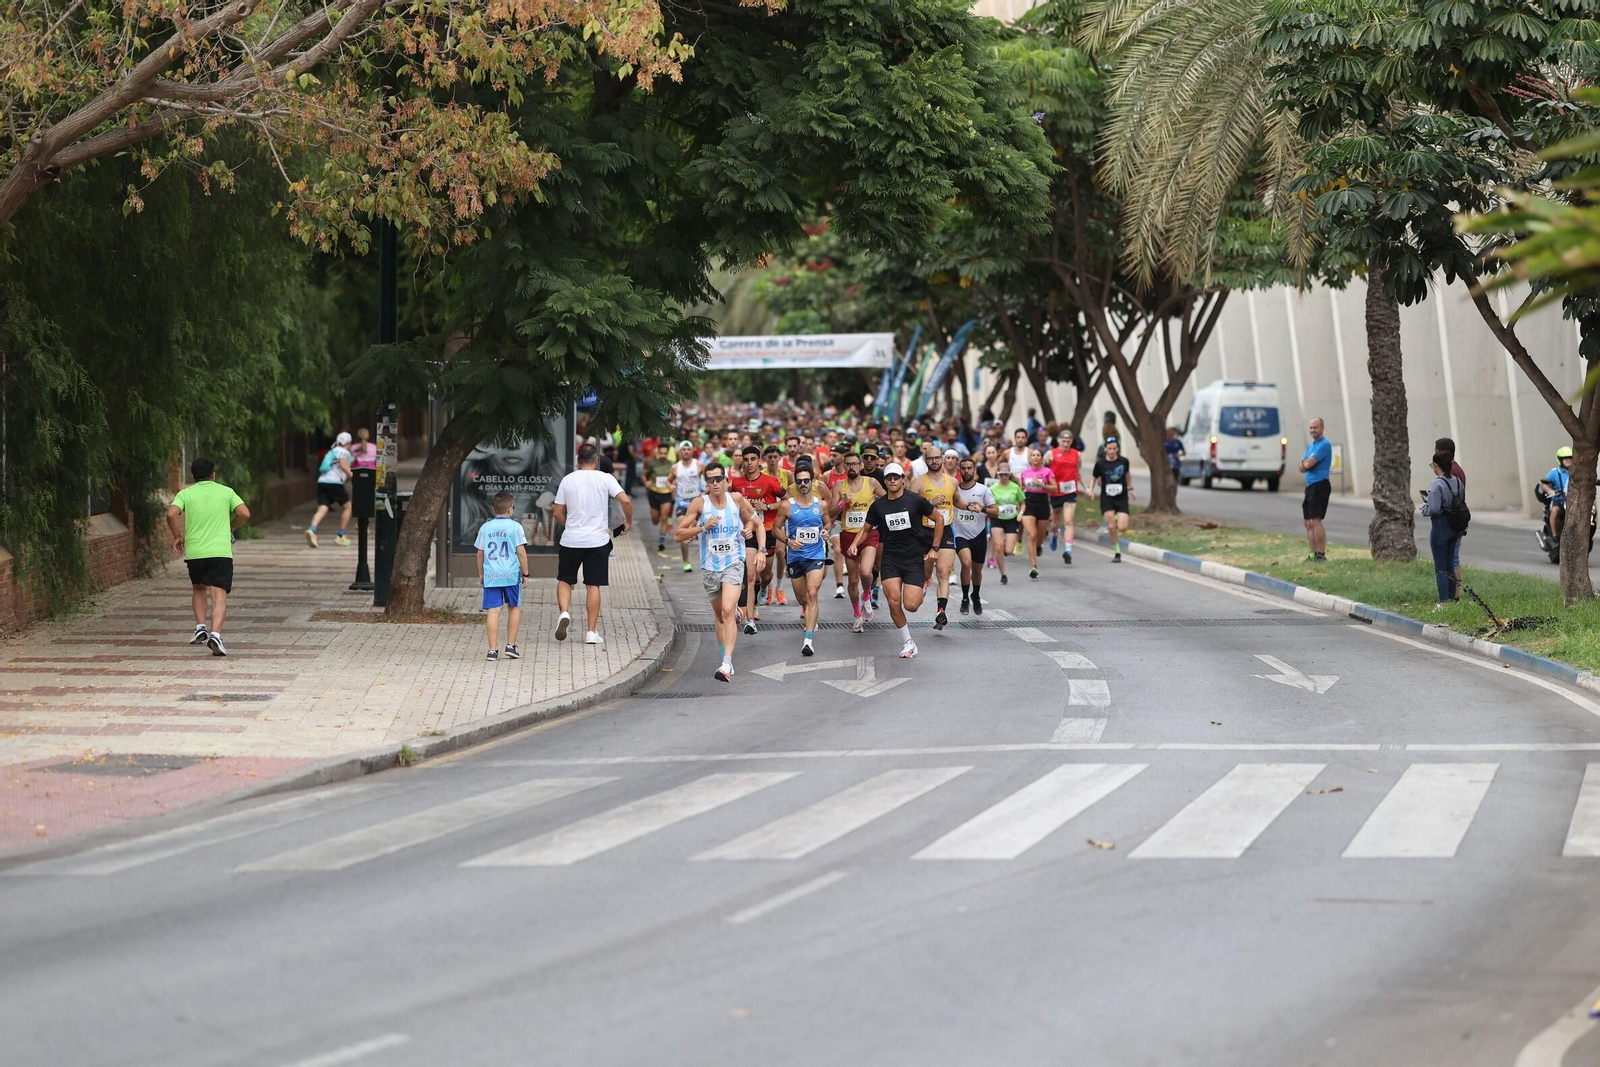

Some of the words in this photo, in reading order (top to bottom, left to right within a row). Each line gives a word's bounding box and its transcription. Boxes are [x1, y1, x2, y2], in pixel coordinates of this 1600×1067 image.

[719, 340, 762, 349] Carrera
[765, 339, 779, 348] de
[796, 338, 834, 347] Prensa
[472, 475, 515, 483] CABELLO
[517, 475, 553, 483] GLOSSY
[485, 483, 502, 491] DÍAS
[504, 484, 546, 492] ANTI-FRIZZ
[889, 517, 906, 527] 859
[799, 531, 816, 539] 510
[487, 540, 510, 561] 24
[712, 543, 731, 552] 125
